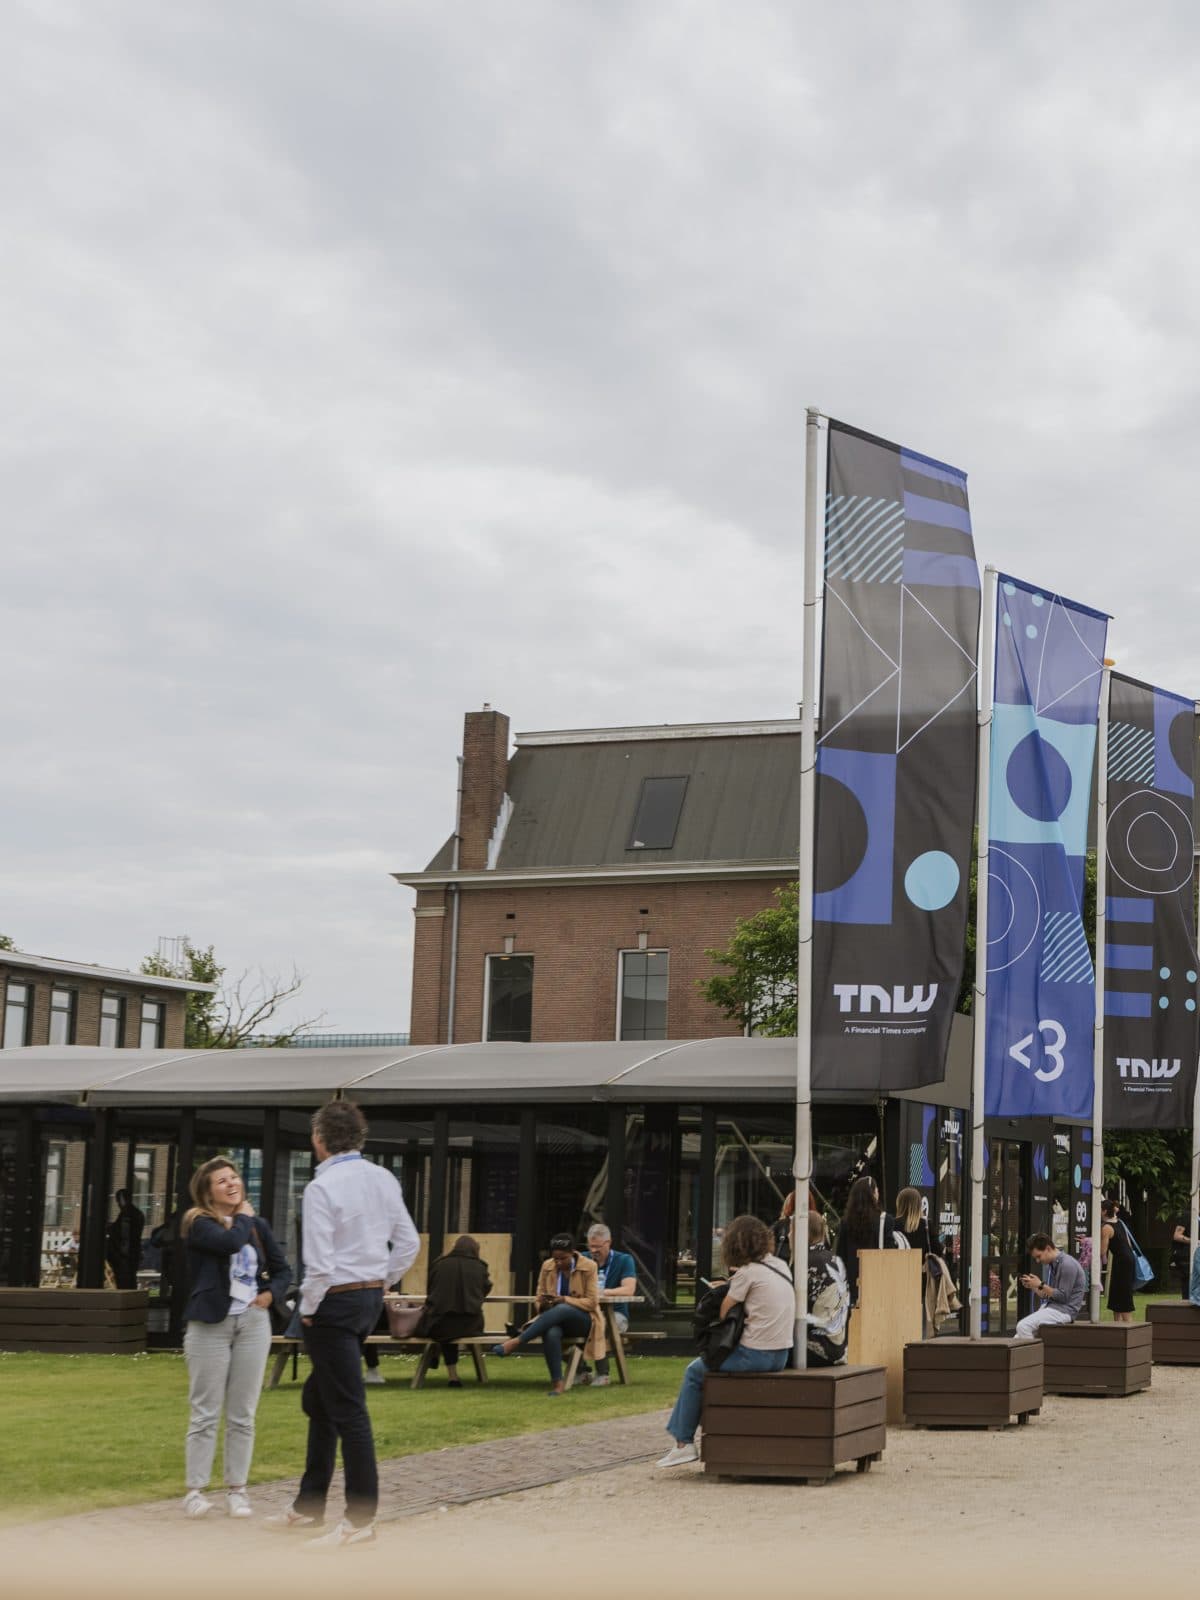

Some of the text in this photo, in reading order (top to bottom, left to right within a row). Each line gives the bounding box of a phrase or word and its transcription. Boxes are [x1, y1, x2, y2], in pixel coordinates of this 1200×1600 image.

[833, 983, 939, 1014] TNW
[851, 1026, 880, 1034] Financial
[881, 1026, 901, 1035] Times
[1009, 1019, 1067, 1082] <3
[1116, 1057, 1181, 1078] TNW
